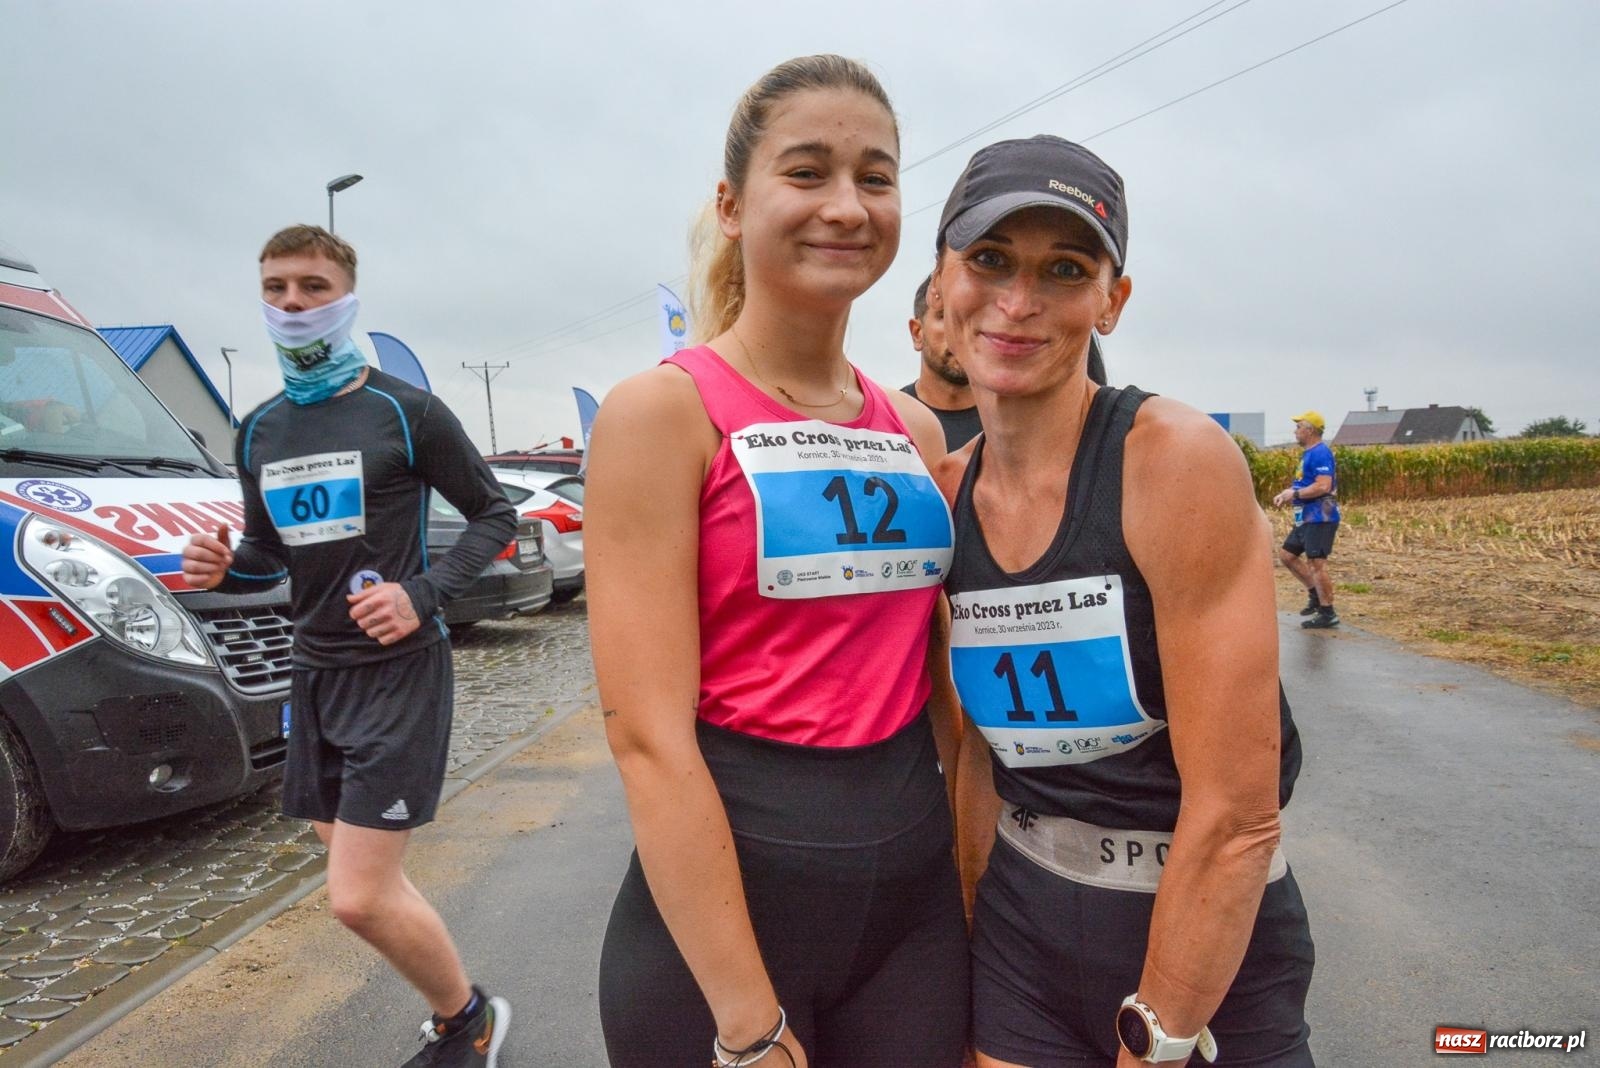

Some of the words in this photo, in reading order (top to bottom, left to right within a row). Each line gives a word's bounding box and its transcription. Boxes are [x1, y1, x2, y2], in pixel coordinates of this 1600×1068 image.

[1049, 179, 1096, 208] Reebok
[745, 432, 787, 449] Eko
[791, 431, 841, 446] Cross
[843, 438, 886, 452] przez
[885, 439, 912, 454] Las
[797, 450, 831, 460] Kornice,
[336, 458, 355, 466] Las
[291, 484, 330, 522] 60
[821, 475, 907, 545] 12
[972, 603, 1011, 619] Cross
[1014, 598, 1063, 620] przez
[1067, 592, 1108, 609] Las
[975, 624, 998, 635] Kornice,
[998, 624, 1006, 634] 30
[1036, 620, 1056, 631] 2023
[993, 650, 1079, 722] 11
